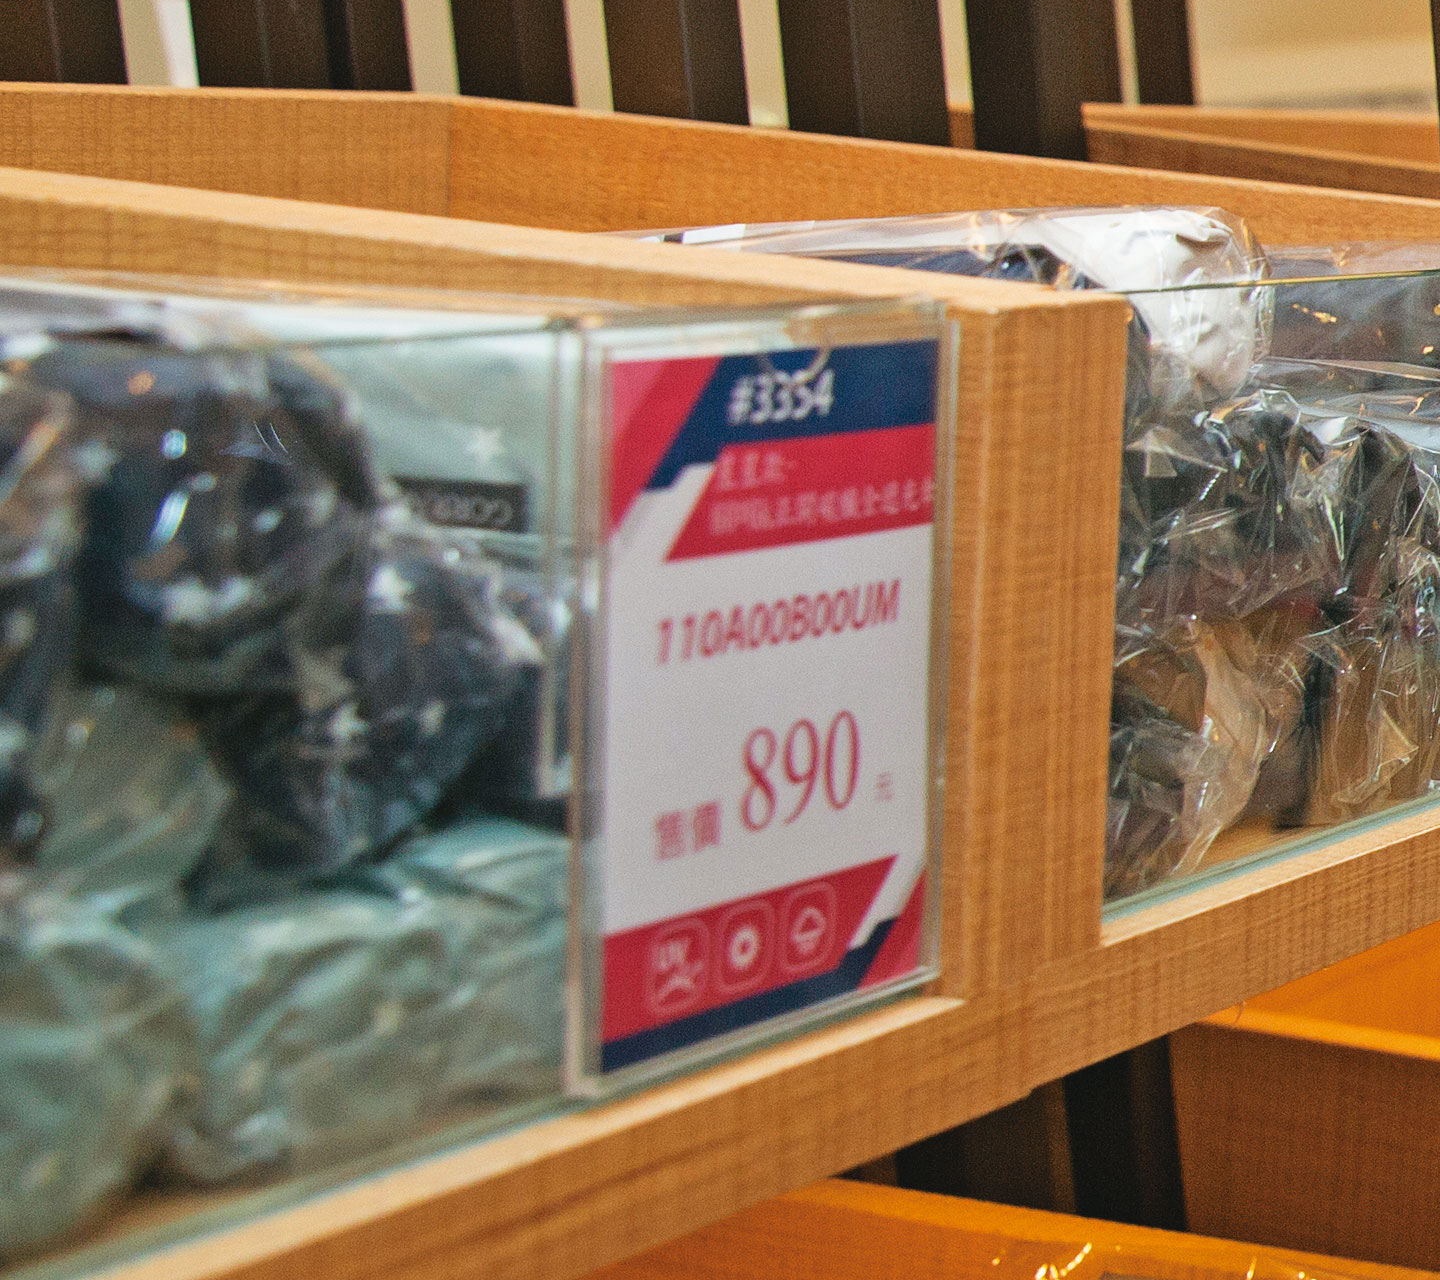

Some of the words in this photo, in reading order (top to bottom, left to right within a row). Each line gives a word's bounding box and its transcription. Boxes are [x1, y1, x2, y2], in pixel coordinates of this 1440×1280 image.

[727, 369, 834, 425] #3354
[657, 578, 900, 664] 110A00B00UM
[740, 709, 859, 831] 890
